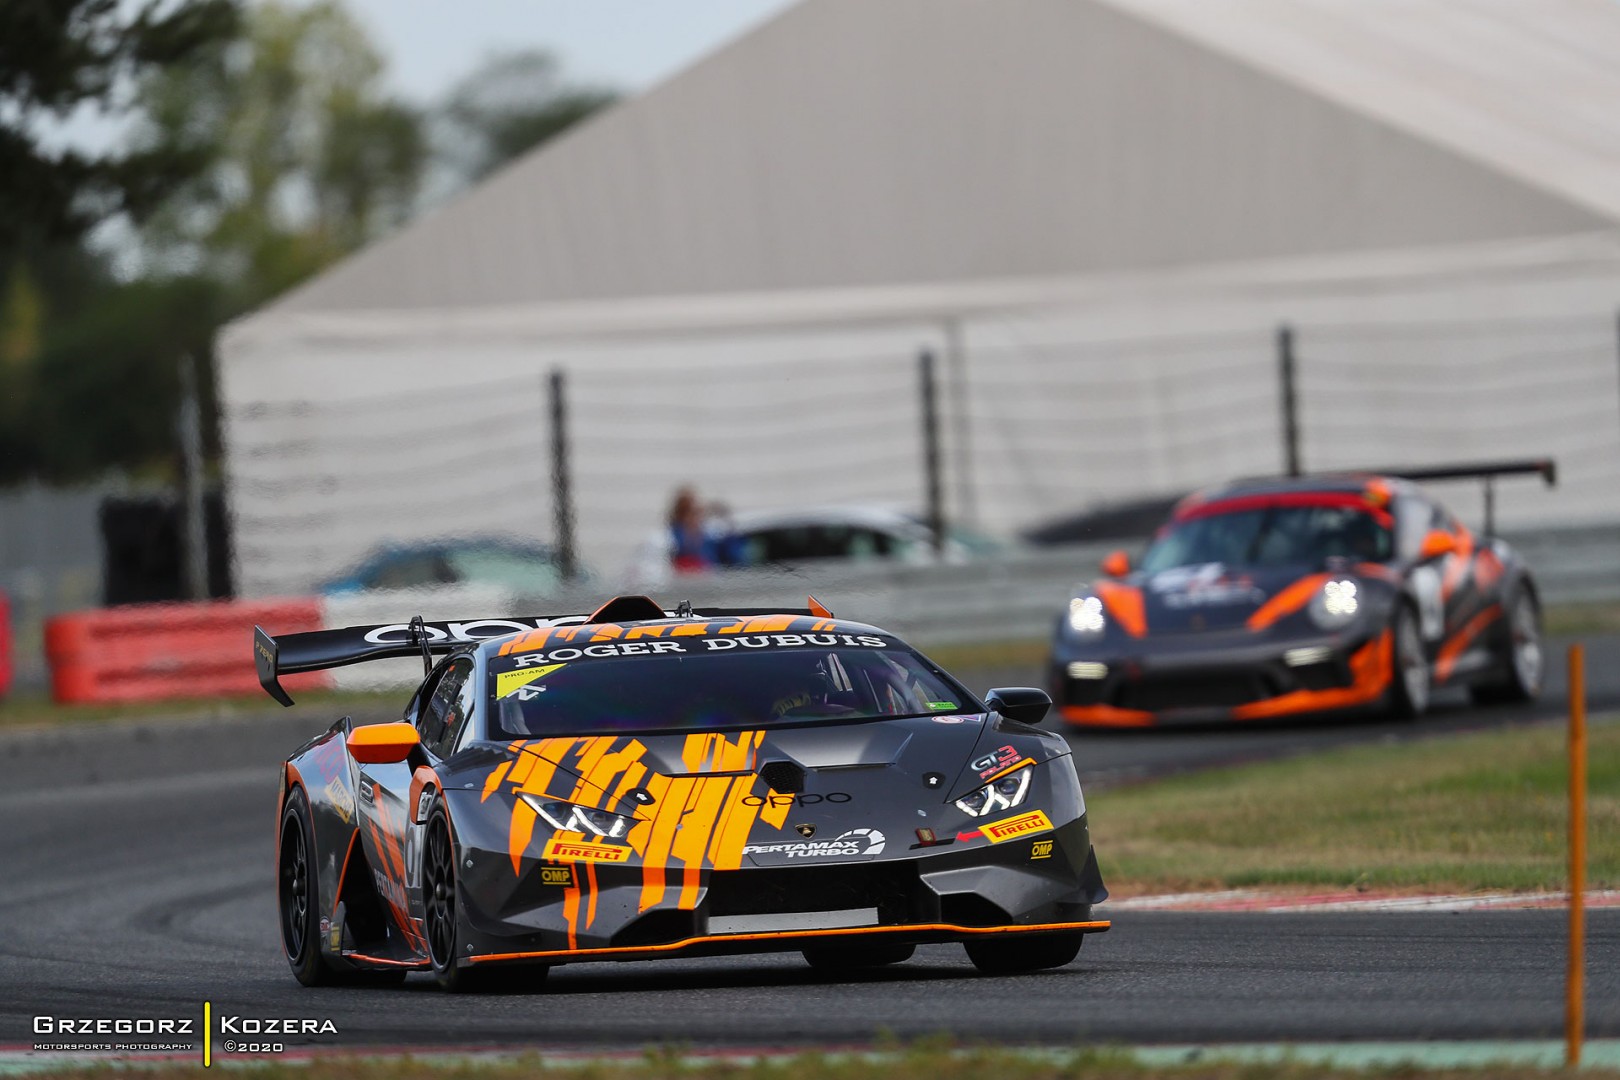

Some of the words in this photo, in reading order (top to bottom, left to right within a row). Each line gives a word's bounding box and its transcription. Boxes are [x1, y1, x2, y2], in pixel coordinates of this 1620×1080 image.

[364, 612, 703, 643] op
[513, 641, 687, 668] ROGER
[702, 634, 887, 651] DUBUIS
[504, 668, 546, 679] PRO-AM
[971, 745, 1018, 771] GT3
[742, 792, 852, 808] oppo
[988, 814, 1045, 838] PIRELLI
[551, 842, 623, 860] PIRELLI
[741, 840, 860, 855] PERTAMAX
[785, 848, 860, 858] TURBO
[1031, 843, 1053, 856] OMP
[541, 870, 570, 882] OMP
